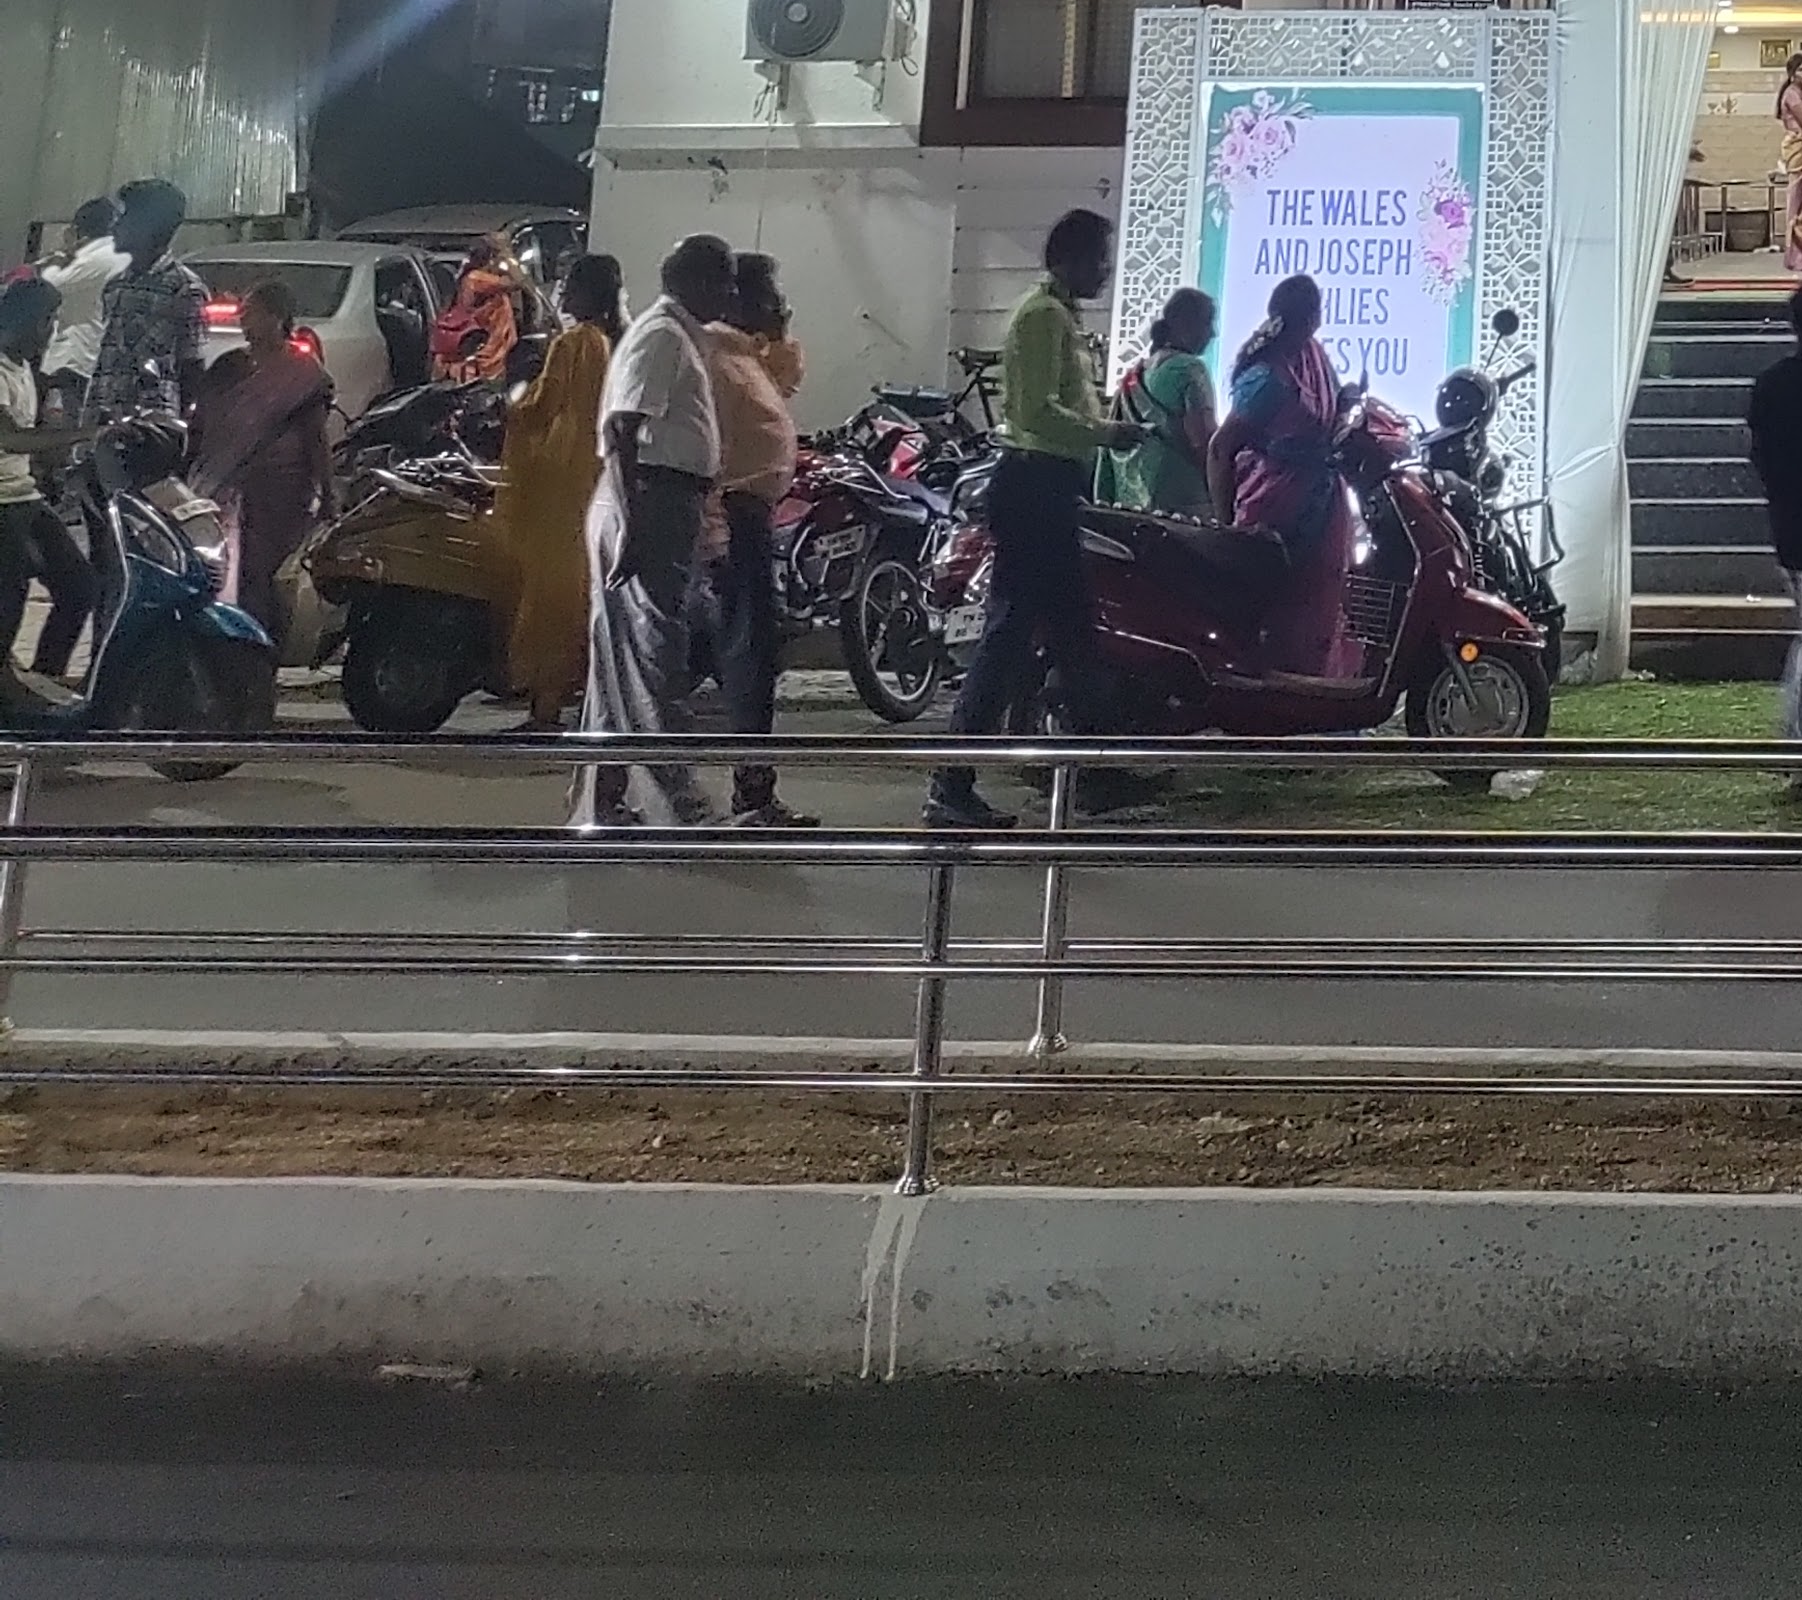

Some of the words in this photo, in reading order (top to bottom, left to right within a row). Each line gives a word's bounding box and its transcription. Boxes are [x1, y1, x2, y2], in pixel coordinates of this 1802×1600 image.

[1267, 189, 1315, 226] THE
[1321, 189, 1407, 226] WALES
[1254, 238, 1309, 275] AND
[1313, 238, 1412, 276] JOSEPH
[1321, 287, 1389, 325] ILIES
[1358, 337, 1409, 375] YOU
